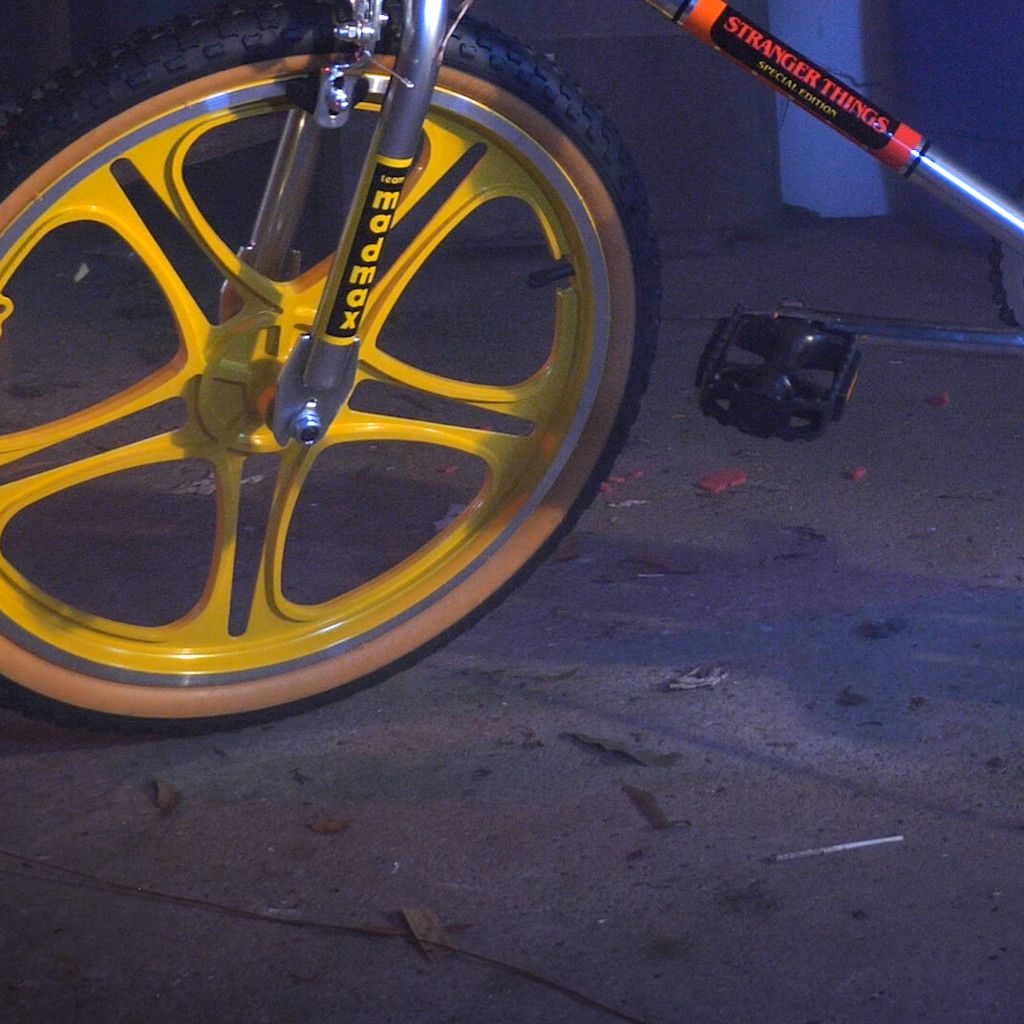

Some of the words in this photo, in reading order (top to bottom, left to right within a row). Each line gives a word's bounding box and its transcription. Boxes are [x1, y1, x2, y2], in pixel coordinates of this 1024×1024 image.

[723, 16, 821, 88] STRANGER
[821, 78, 890, 133] THINGS
[757, 61, 801, 93] SPECIAL
[799, 89, 838, 119] EDITION
